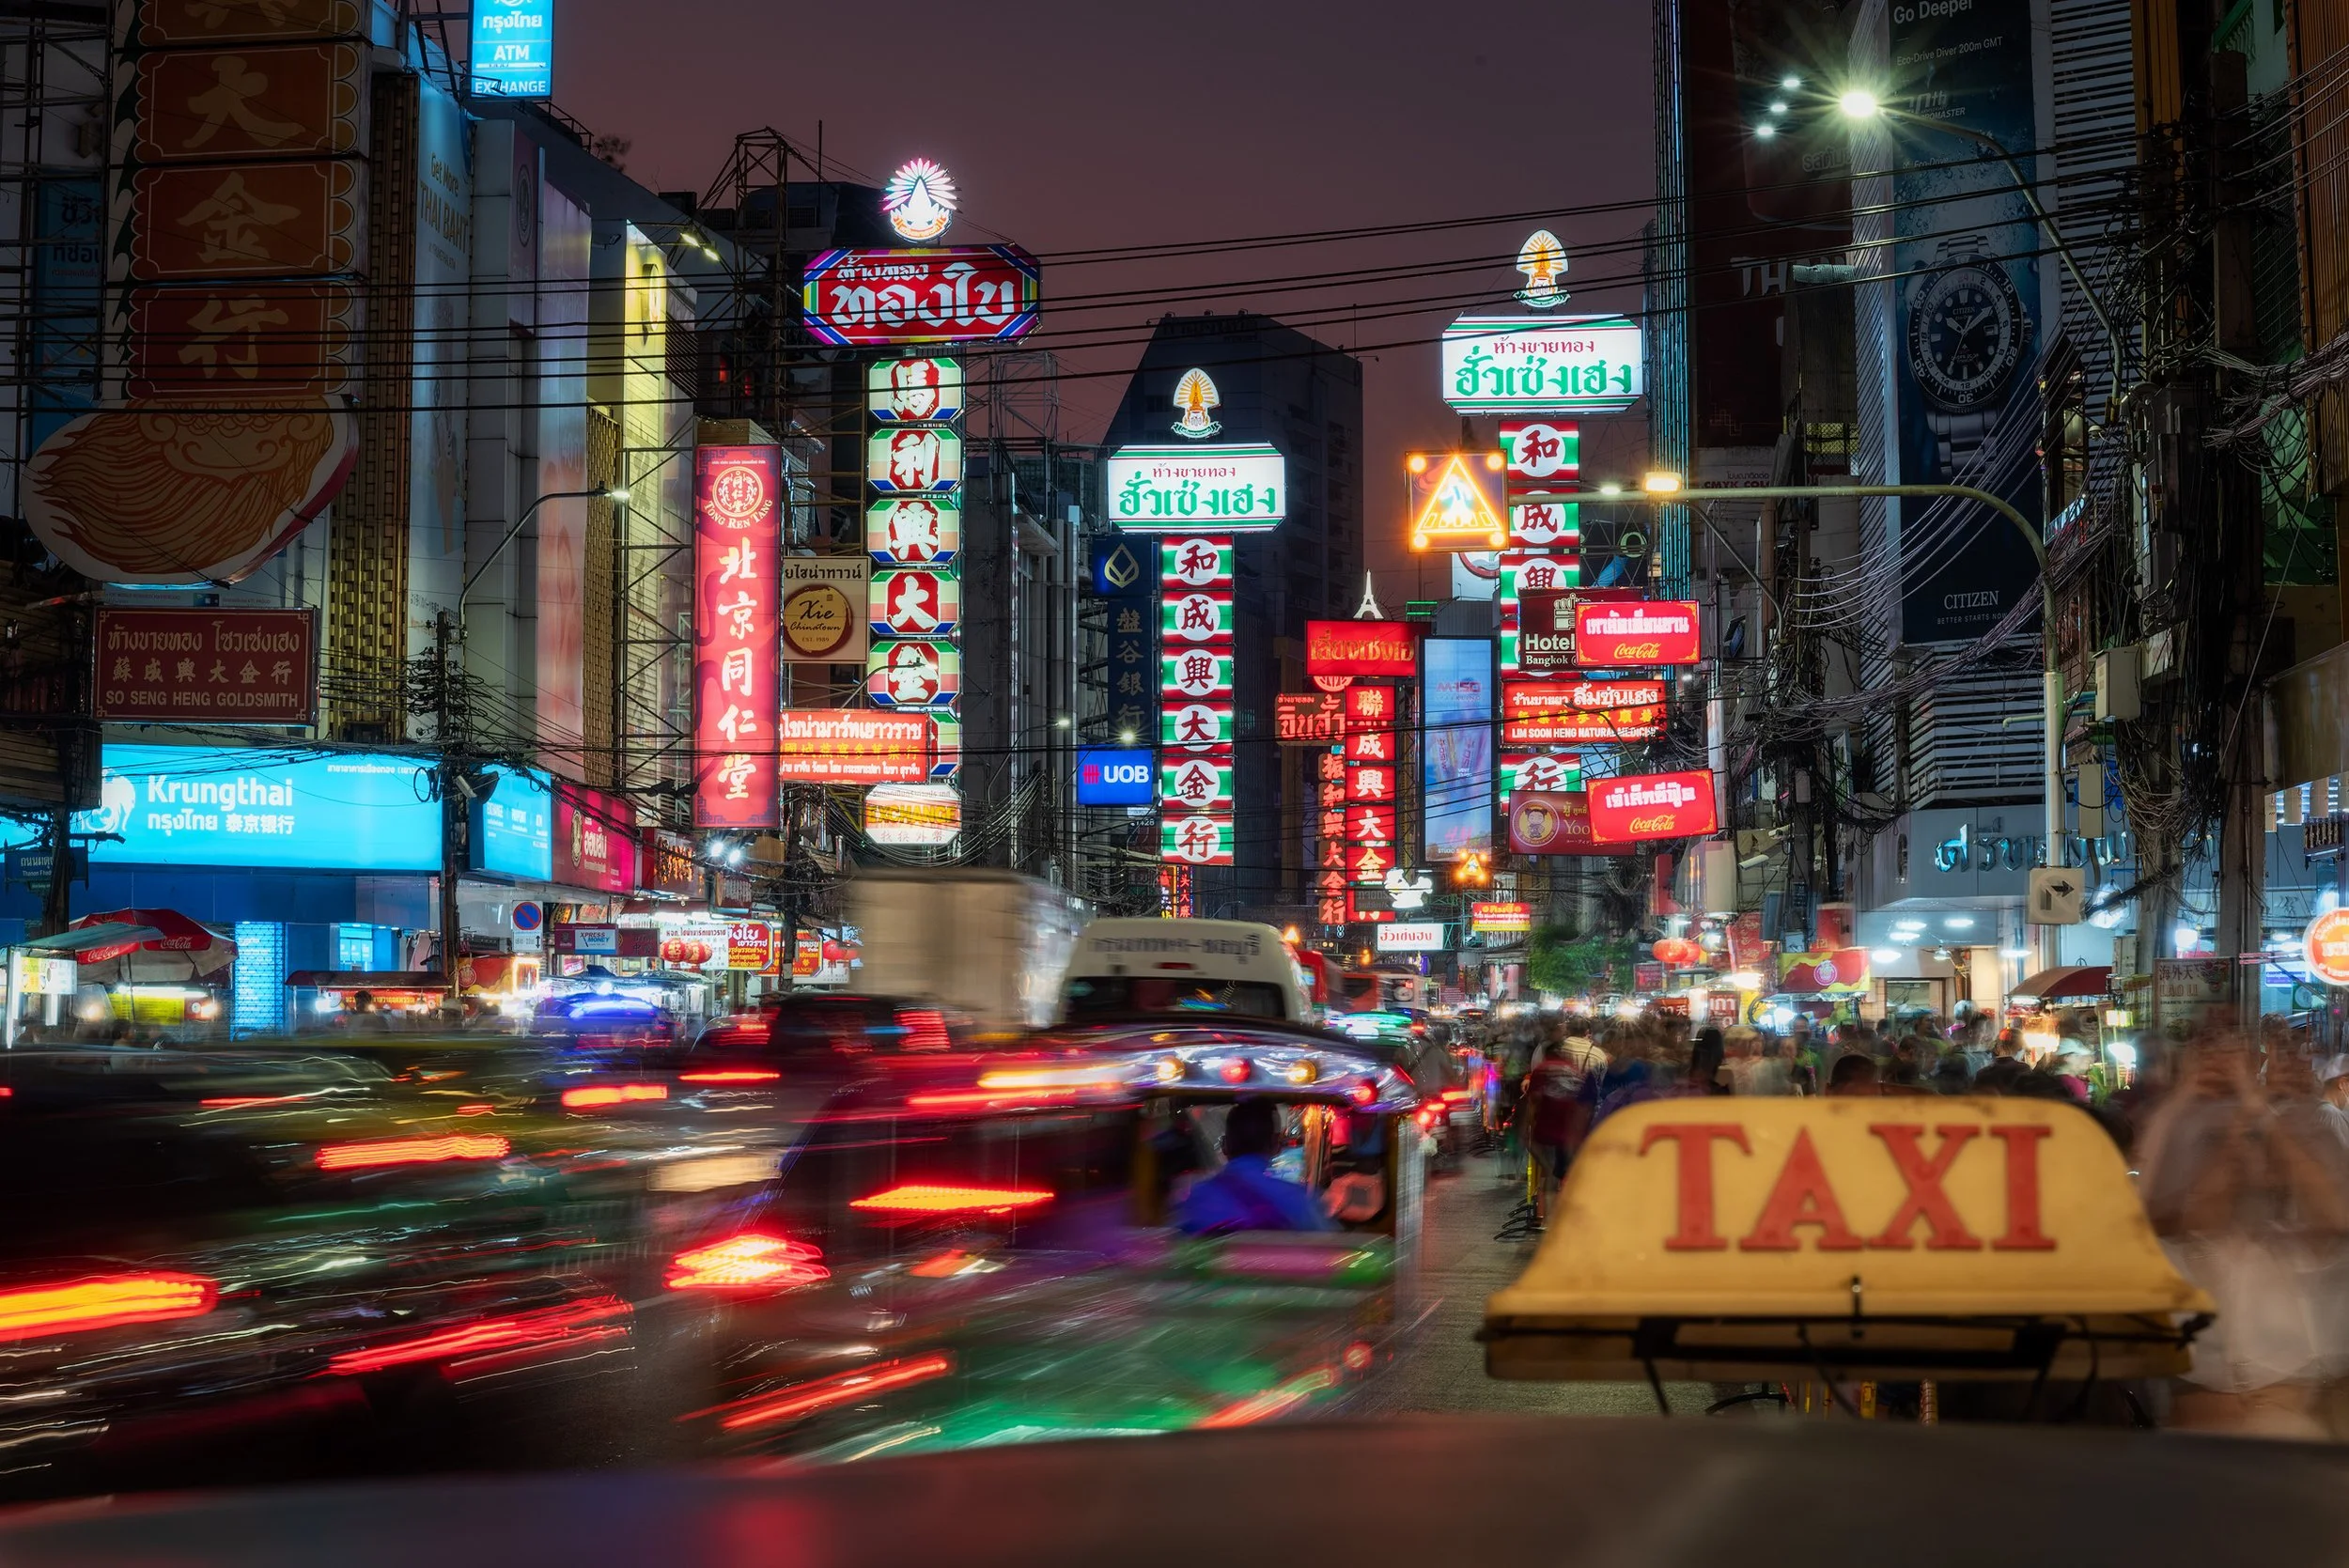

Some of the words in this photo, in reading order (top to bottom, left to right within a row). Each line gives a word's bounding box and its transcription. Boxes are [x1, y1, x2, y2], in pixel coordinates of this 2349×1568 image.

[482, 10, 543, 35] กรุงไทย
[1893, 4, 1914, 23] Go
[493, 45, 530, 61] ATM
[1896, 50, 1936, 67] Eco-Drive
[1937, 46, 1957, 60] Diver
[1958, 41, 1983, 56] 200m
[1983, 36, 2004, 50] GMT
[474, 80, 547, 94] EXCHANGE
[1492, 336, 1595, 354] ห้างขายทอง
[1455, 345, 1633, 396] ฮั่วเซ่งเฮง
[1152, 462, 1237, 479] ห้างขายทอง
[1118, 470, 1278, 518] ฮั่วเซ่งเฮง
[704, 499, 727, 527] TONG
[726, 517, 752, 529] REN
[750, 498, 774, 524] TANG
[799, 600, 835, 620] Xie
[1943, 590, 1999, 611] CITIZEN
[789, 621, 842, 631] Chinatown
[1937, 615, 1962, 625] BETTER
[1964, 613, 1990, 623] STARTS
[107, 623, 204, 652] ห้างขายทอง
[1525, 632, 1576, 651] Hotel
[111, 656, 294, 686] 蘇成興大金行
[717, 536, 758, 800] 北京同仁堂
[1115, 607, 1145, 728] 盤谷銀行
[1525, 655, 1568, 667] Bangkok
[105, 690, 125, 705] SO
[130, 690, 167, 706] SENG
[172, 691, 211, 706] HENG
[216, 692, 299, 707] GOLDSMITH
[1178, 543, 1219, 859] 和成興大金行
[1512, 727, 1527, 738] LIM
[1528, 727, 1552, 738] SOON
[1553, 727, 1578, 738] HENG
[1103, 764, 1149, 784] UOB
[147, 775, 294, 812] Krungthai
[147, 807, 219, 837] กรุงไทย
[224, 813, 296, 835] 泰京银行
[866, 803, 959, 825] EXCHANGE
[1638, 1123, 2057, 1251] TAXI
